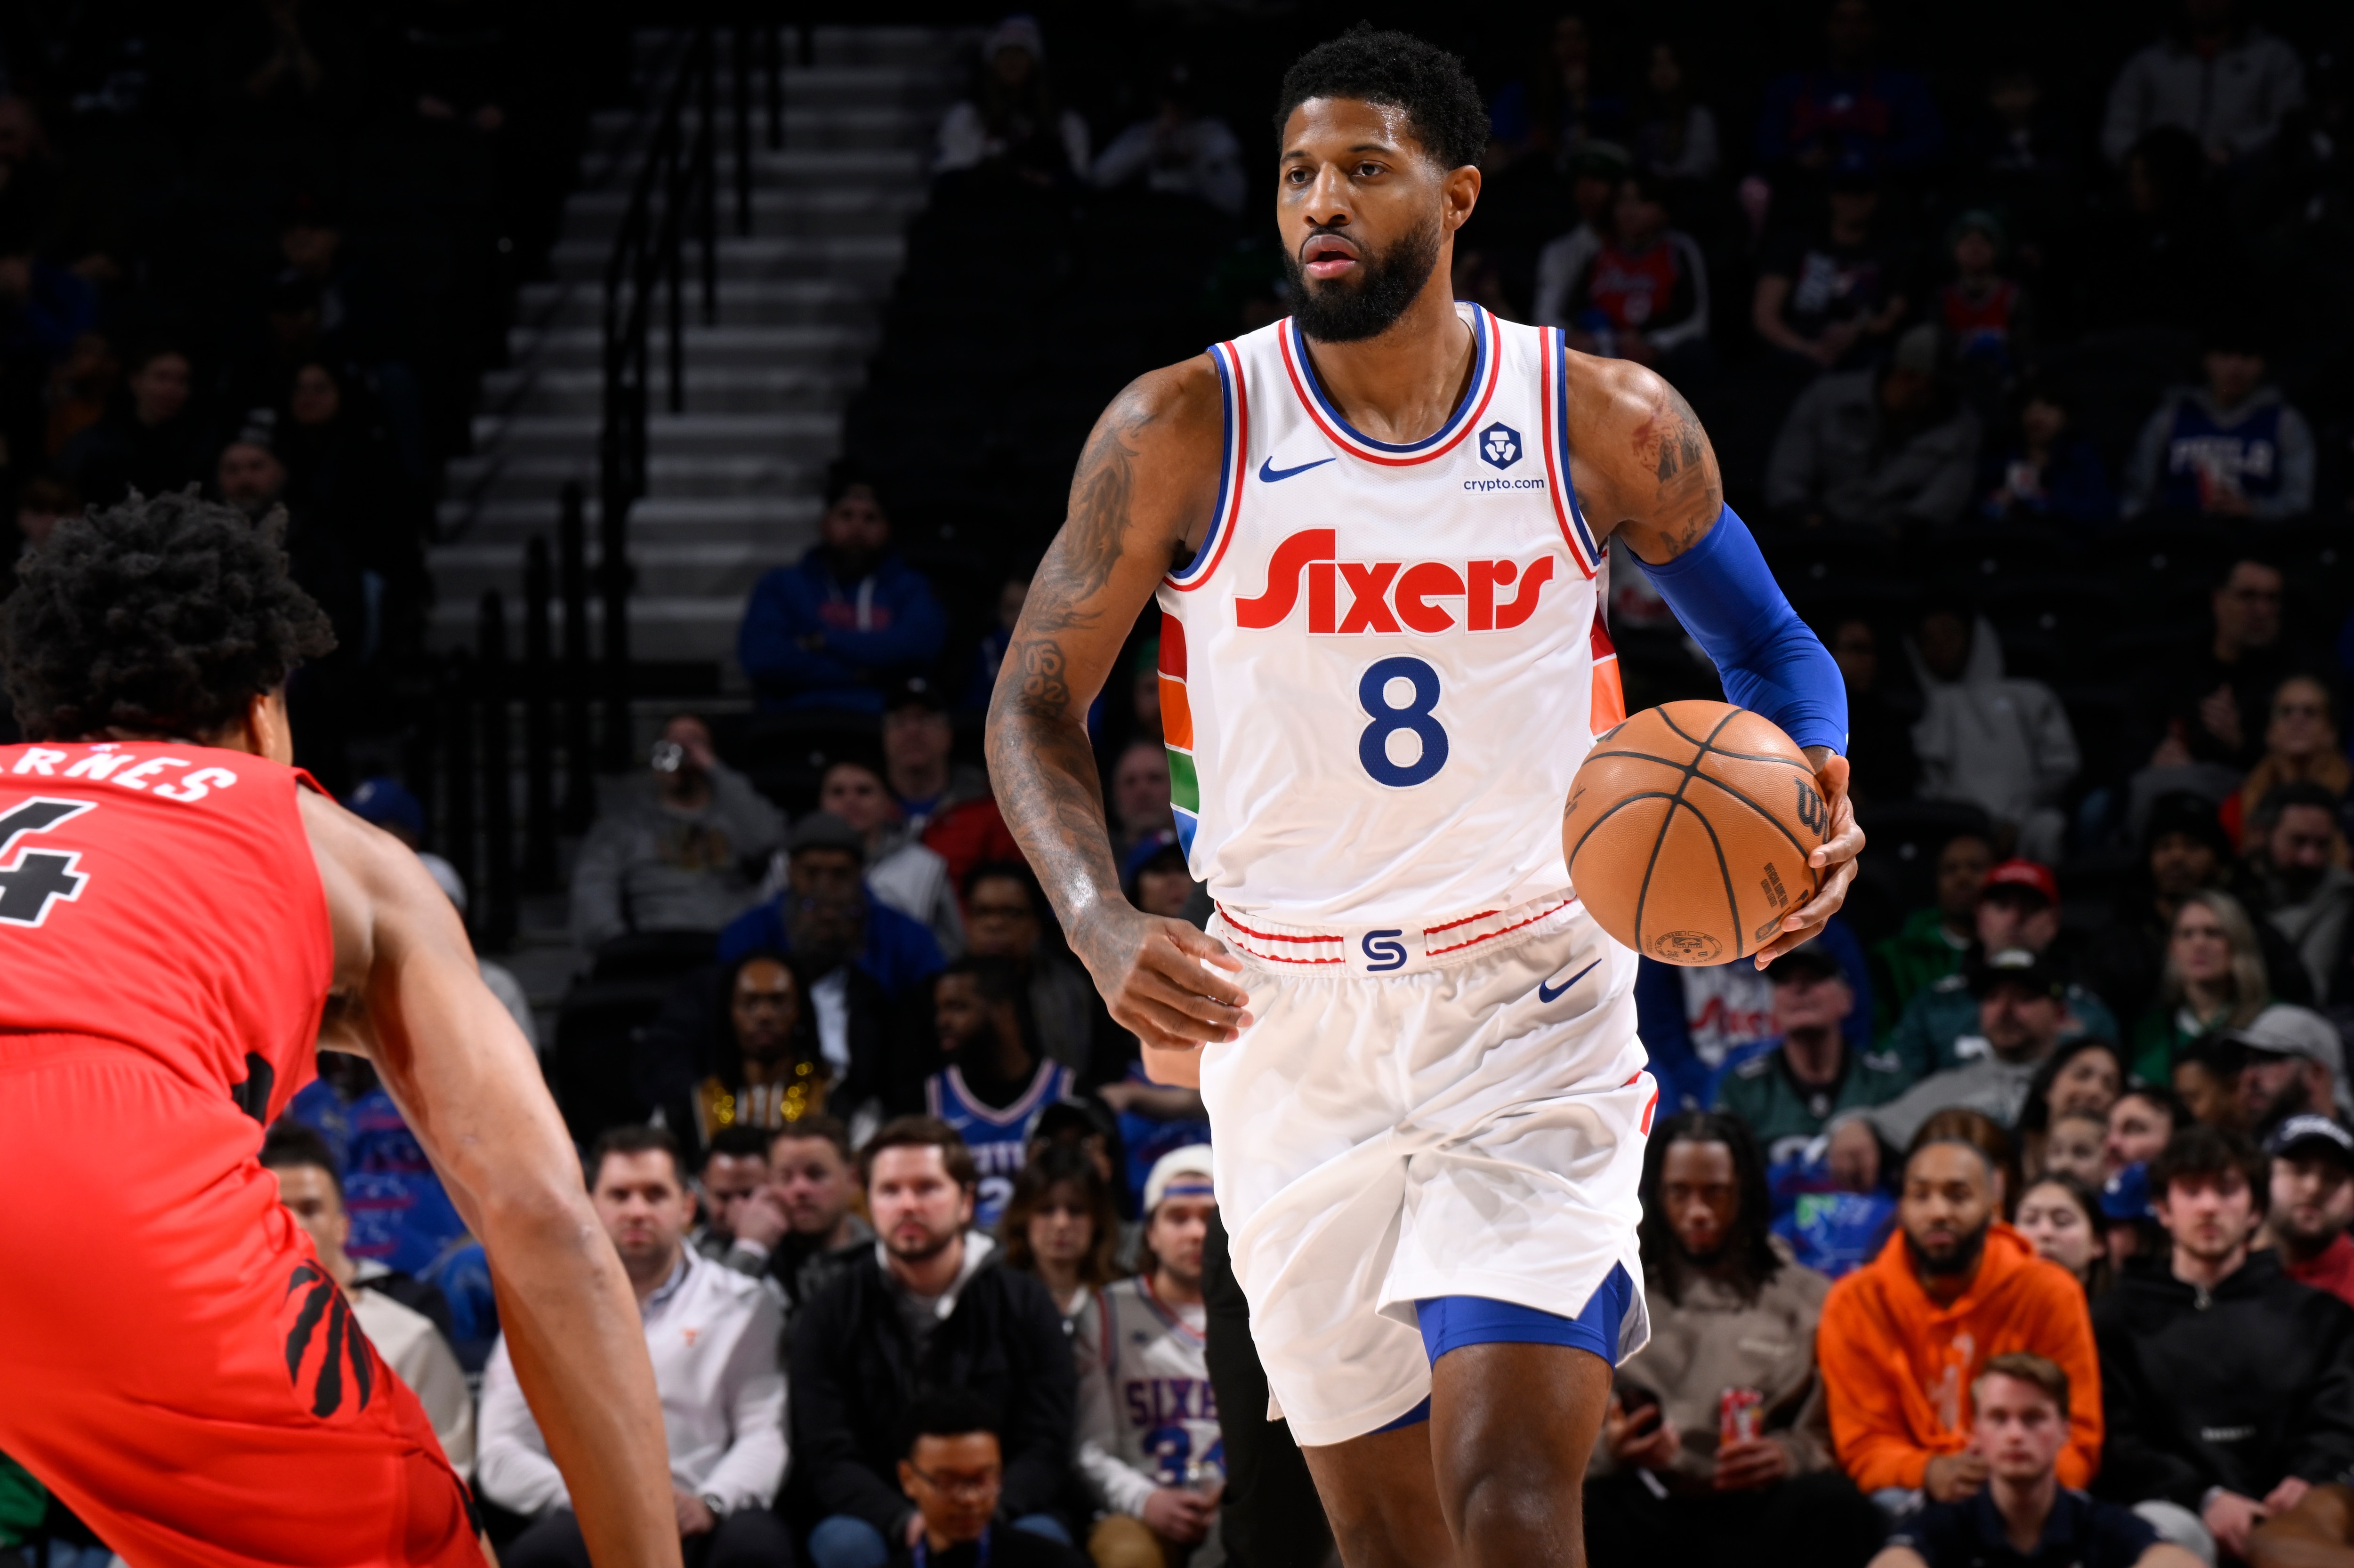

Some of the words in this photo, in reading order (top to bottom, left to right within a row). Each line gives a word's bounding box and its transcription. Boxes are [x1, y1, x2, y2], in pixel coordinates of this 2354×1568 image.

[1464, 478, 1545, 491] crypto.com
[1235, 529, 1554, 633] Sixers
[1359, 657, 1449, 787] 8
[0, 748, 237, 801] RNES
[0, 796, 98, 927] 4
[1127, 1378, 1218, 1426] SIXE
